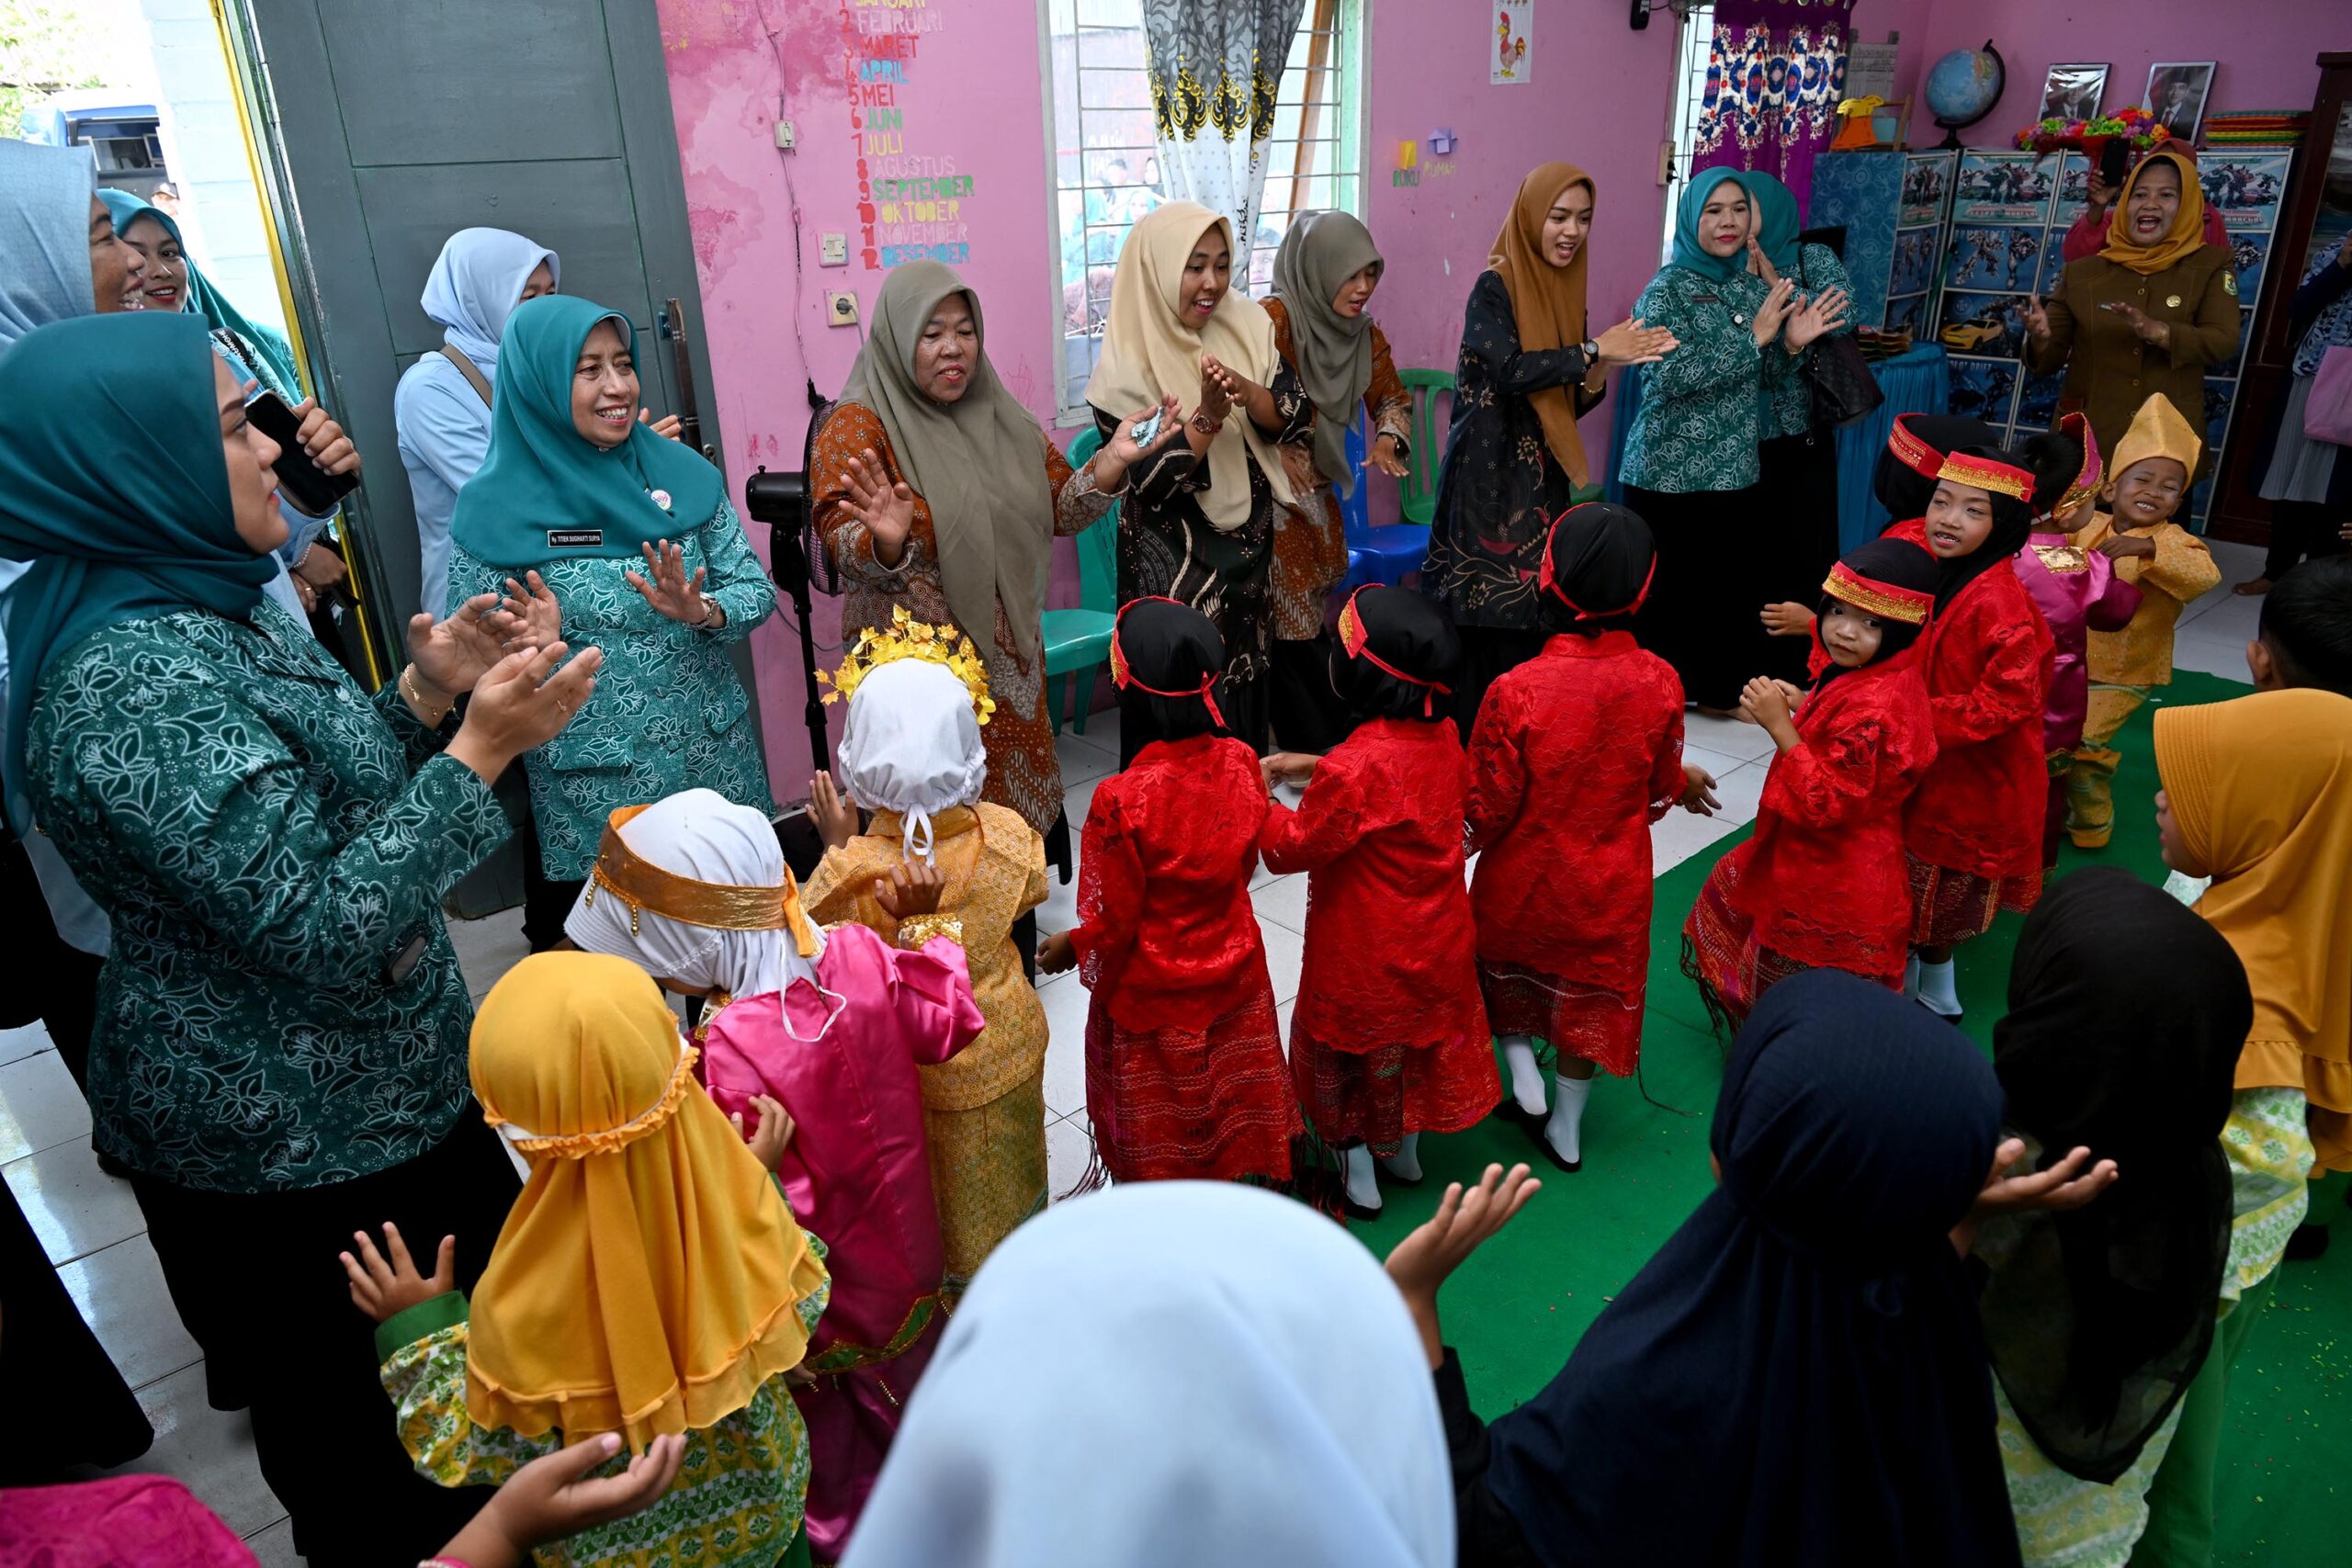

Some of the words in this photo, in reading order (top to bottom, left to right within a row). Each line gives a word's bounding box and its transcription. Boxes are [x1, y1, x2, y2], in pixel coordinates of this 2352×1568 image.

[839, 9, 854, 33] 2
[857, 9, 944, 34] FEBRUARI
[842, 36, 854, 59] 3
[860, 35, 919, 59] MARET
[844, 59, 857, 82] 4
[860, 60, 910, 84] APRIL
[848, 84, 859, 106] 5
[863, 84, 894, 107] MEI
[852, 107, 863, 130] 6
[865, 109, 903, 130] JUNI
[851, 133, 862, 157] 7
[866, 133, 903, 156] JULI
[856, 159, 868, 179] 8
[875, 155, 956, 178] AGUSTUS
[1393, 170, 1420, 187] BUKU
[859, 180, 870, 201] 9
[873, 175, 975, 201] SEPTEMBER
[856, 202, 876, 224] 10
[881, 200, 959, 224] OKTOBER
[861, 225, 875, 246] 11
[879, 223, 967, 244] NOVEMBER
[861, 248, 879, 270] 12
[881, 243, 970, 268] DESEMBER
